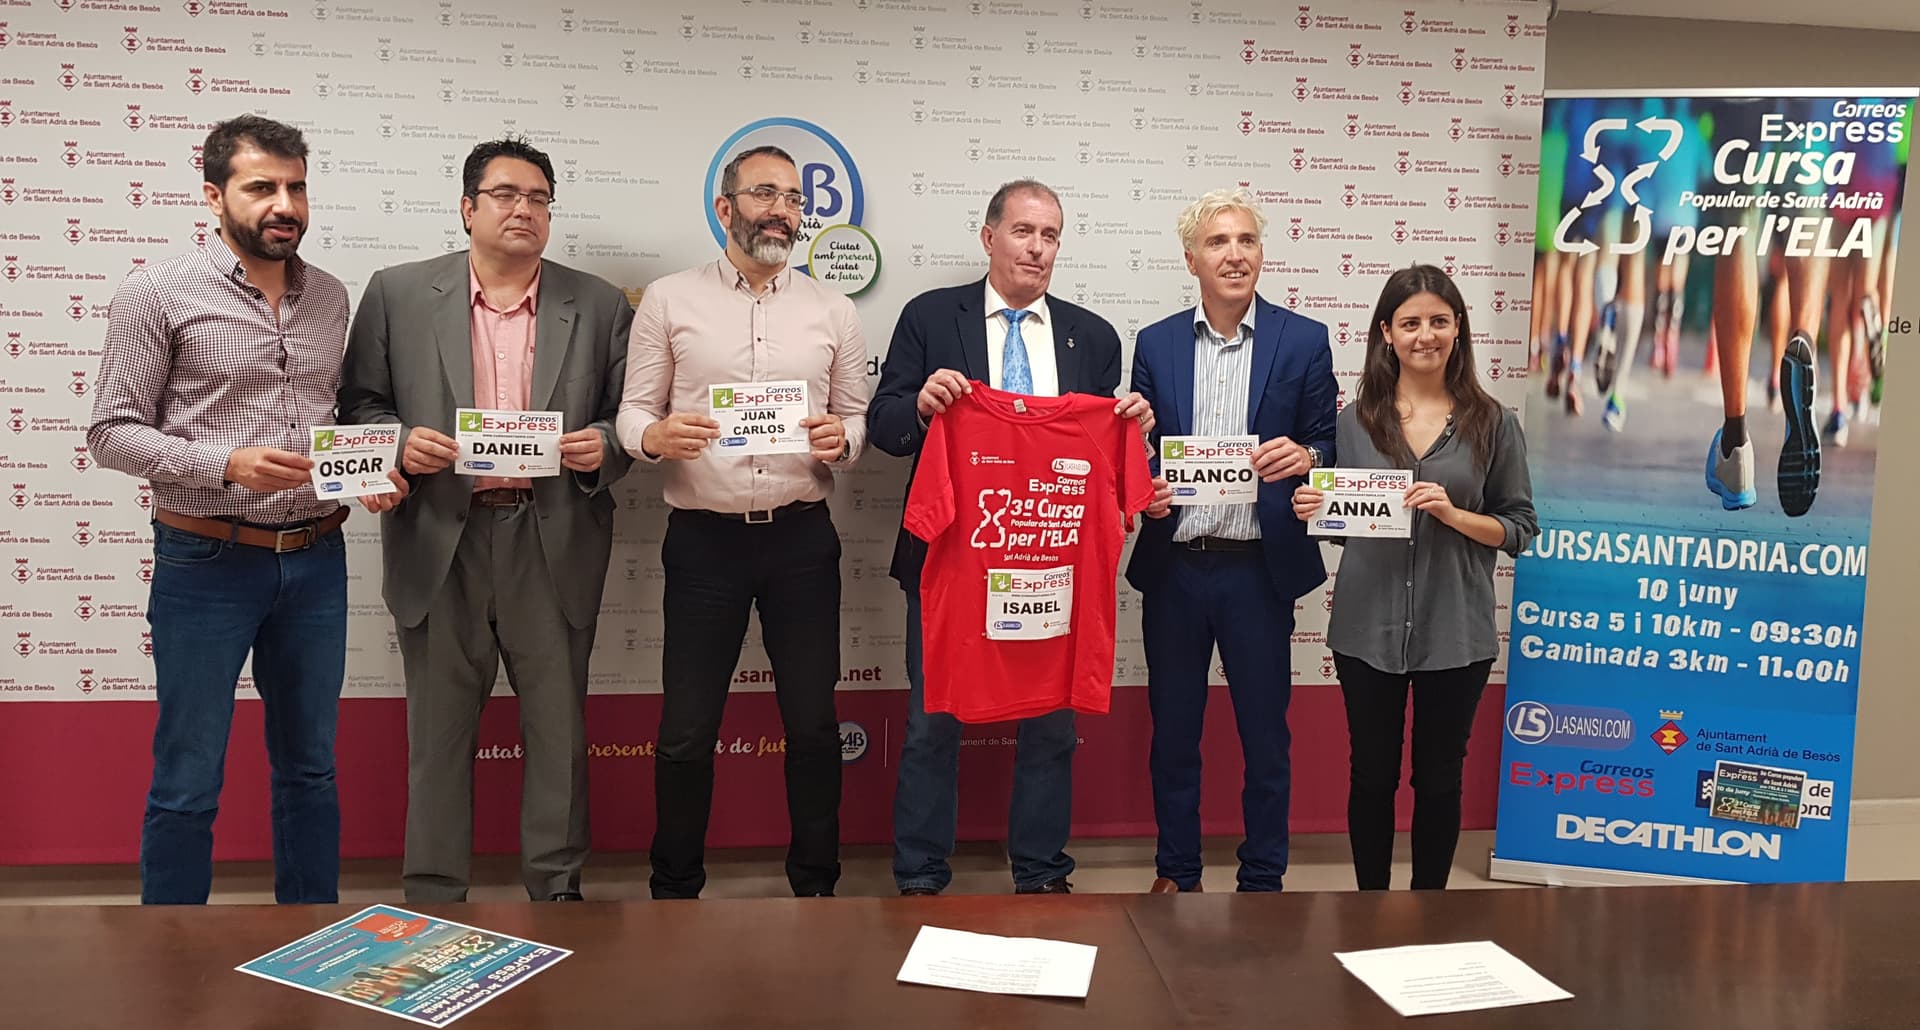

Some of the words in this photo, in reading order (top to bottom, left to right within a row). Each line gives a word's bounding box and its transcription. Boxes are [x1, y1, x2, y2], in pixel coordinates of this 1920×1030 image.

[211, 78, 250, 86] Ajuntament
[1833, 100, 1907, 118] Correos
[1760, 114, 1904, 148] Express
[86, 151, 125, 159] Ajuntament
[1713, 139, 1856, 185] Cursa
[1679, 191, 1755, 211] Popular
[1756, 191, 1779, 208] de
[1782, 192, 1827, 209] Sant
[1829, 192, 1884, 210] Adrià
[830, 241, 861, 251] Ciutat
[1662, 224, 1749, 265] per
[1757, 214, 1873, 258] l'ELA
[814, 251, 835, 260] amb
[830, 263, 860, 271] ciutat
[825, 272, 838, 280] de
[838, 272, 865, 282] futur
[1888, 316, 1912, 334] de
[765, 386, 802, 394] Correos
[734, 393, 802, 406] Express
[519, 415, 556, 423] Correos
[741, 411, 776, 421] JUAN
[363, 428, 396, 436] Correos
[482, 418, 557, 432] Express
[733, 424, 785, 435] CARLOS
[333, 434, 395, 448] Express
[473, 442, 544, 456] DANIEL
[1184, 445, 1253, 459] Express
[320, 458, 383, 477] OSCAR
[1057, 475, 1086, 486] Correos
[1165, 469, 1253, 483] BLANCO
[1029, 479, 1085, 495] Express
[1335, 477, 1407, 491] Express
[1037, 499, 1085, 519] Cursa
[1327, 501, 1391, 517] ANNA
[1011, 519, 1038, 528] Popular
[1008, 533, 1036, 551] per
[1040, 529, 1079, 547] l'ELA
[36, 567, 74, 575] Ajuntament
[1044, 572, 1070, 581] Correos
[1011, 577, 1071, 592] Express
[1637, 577, 1669, 602] 10
[1678, 579, 1738, 610] juny
[1003, 600, 1061, 614] ISABEL
[1517, 600, 1600, 630] Cursa
[1608, 612, 1625, 631] 5
[1634, 611, 1642, 634] i
[1651, 613, 1722, 639] 10km
[1750, 620, 1857, 648] 09:30h
[1520, 635, 1659, 668] Caminada
[1668, 648, 1729, 674] 3km
[1757, 655, 1849, 683] 11.00h
[1514, 706, 1547, 737] LS
[1555, 716, 1631, 740] LASANSI.COM
[1697, 728, 1767, 743] Ajuntament
[729, 737, 756, 754] de
[757, 736, 787, 757] fut
[1695, 741, 1712, 752] de
[1715, 742, 1743, 754] Sant
[1746, 745, 1779, 757] Adrià
[1782, 748, 1798, 759] de
[1802, 749, 1841, 762] Besòs
[1580, 759, 1655, 779] Correos
[1510, 761, 1656, 798] Express
[1808, 783, 1831, 798] de
[1555, 813, 1781, 862] DECATHLON
[485, 947, 552, 980] Express
